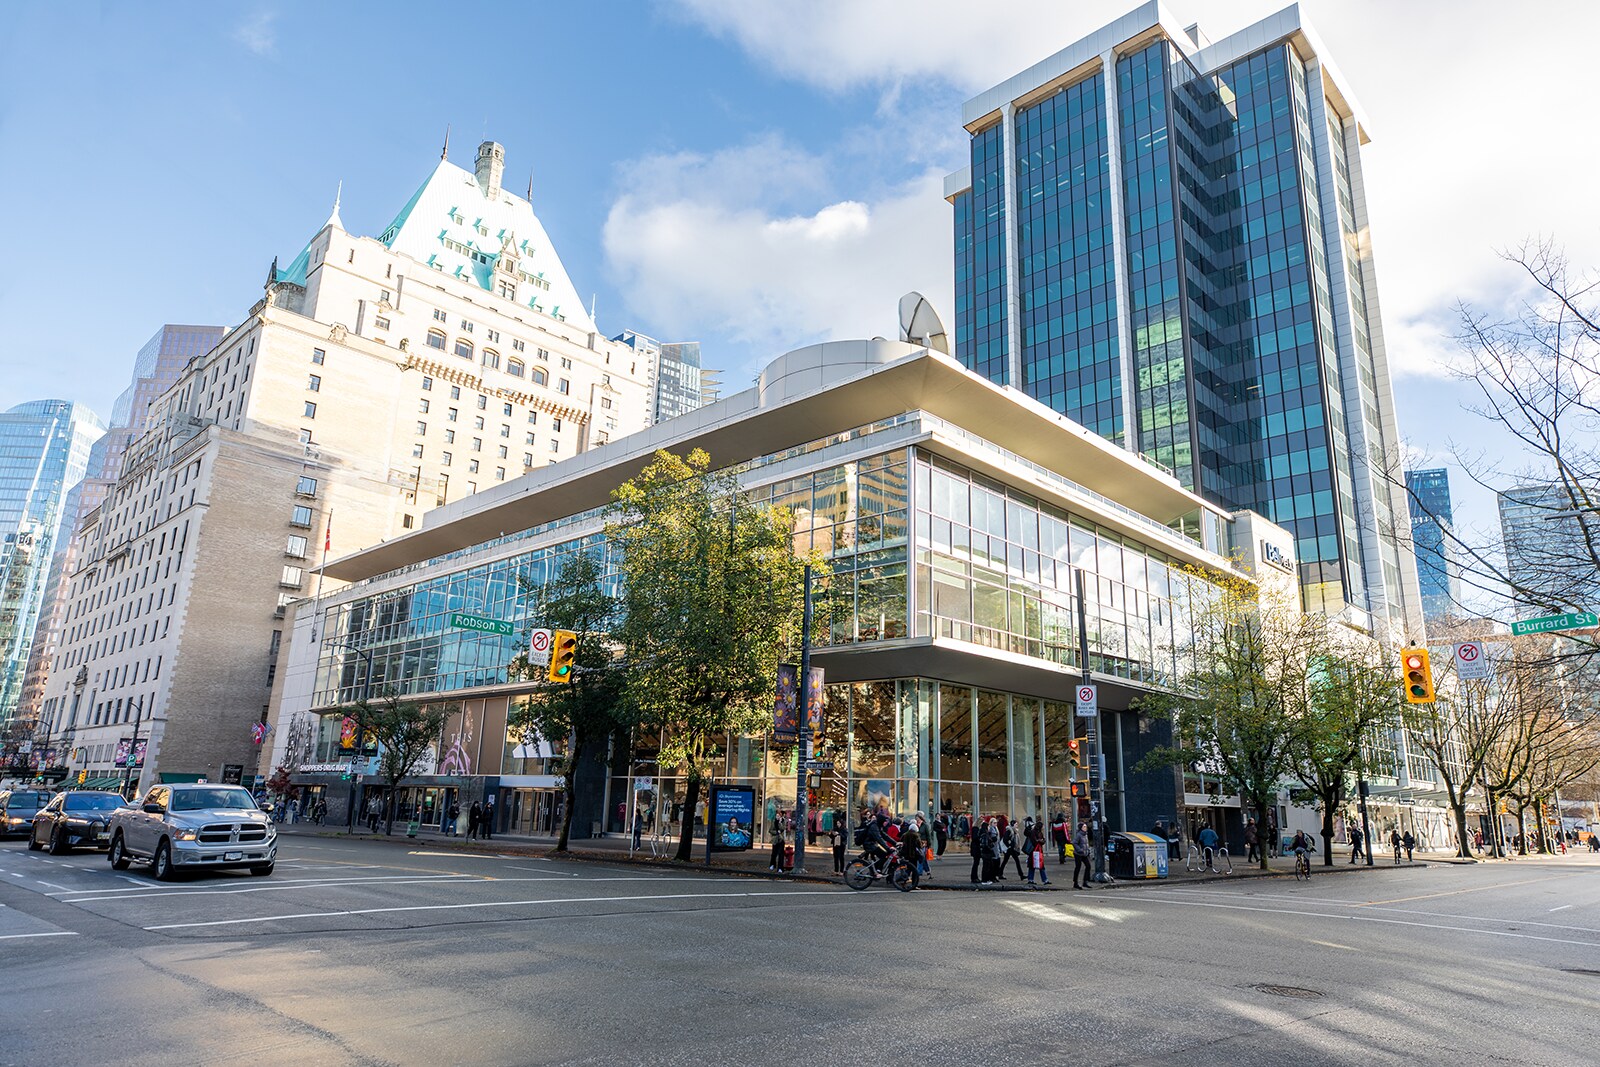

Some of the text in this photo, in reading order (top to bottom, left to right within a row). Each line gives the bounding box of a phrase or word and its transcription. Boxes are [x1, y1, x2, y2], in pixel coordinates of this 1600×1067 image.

[455, 615, 512, 633] Robson St
[1517, 613, 1592, 633] Burrard St
[300, 764, 323, 772] SHOPPERS
[323, 764, 336, 772] DRUG
